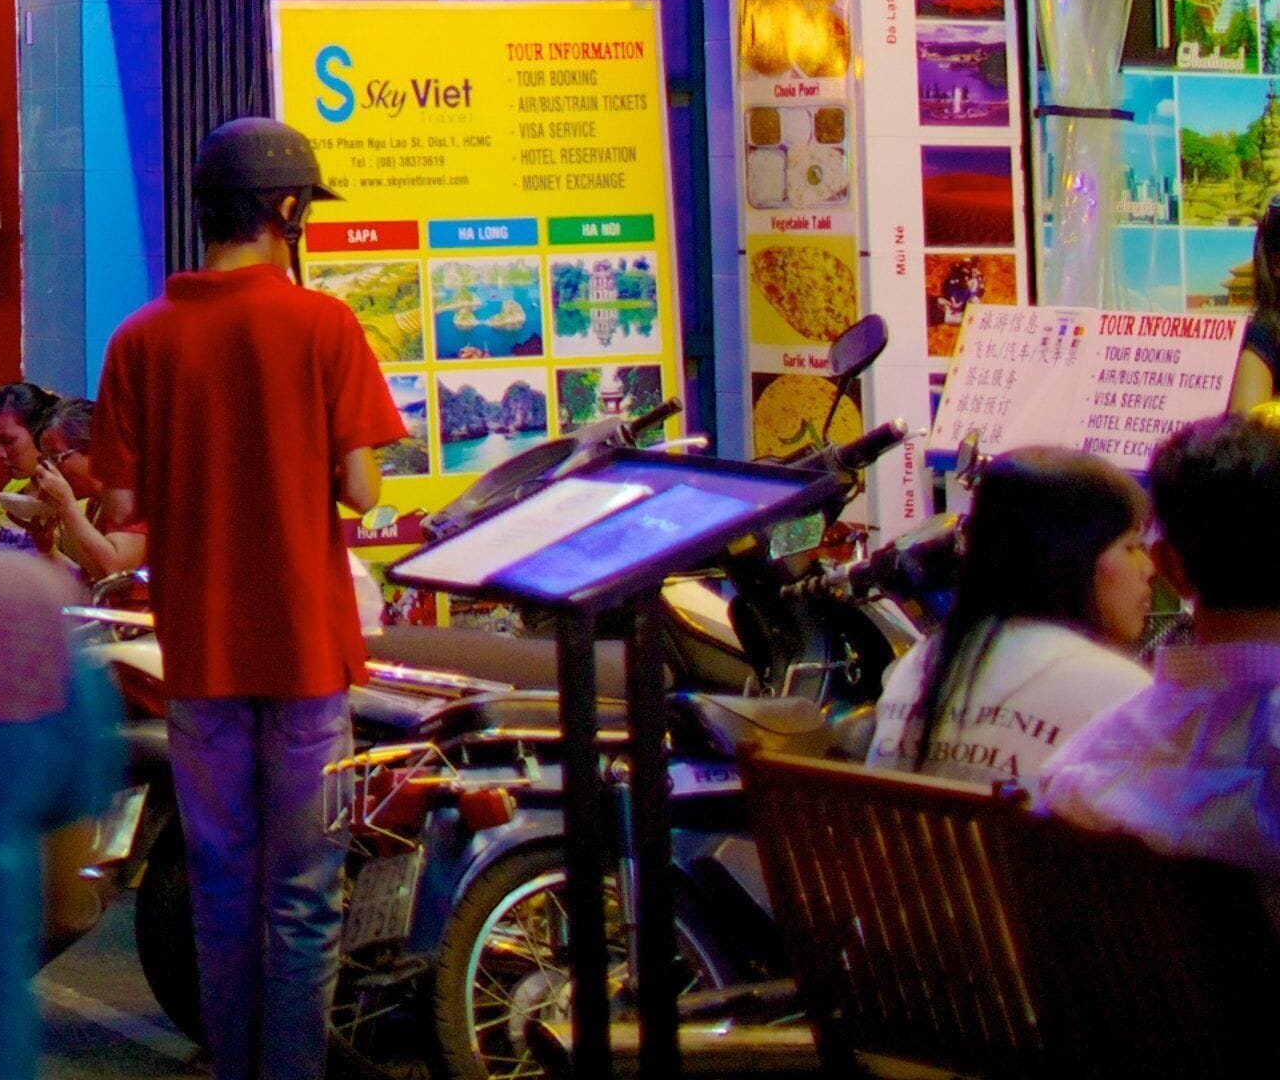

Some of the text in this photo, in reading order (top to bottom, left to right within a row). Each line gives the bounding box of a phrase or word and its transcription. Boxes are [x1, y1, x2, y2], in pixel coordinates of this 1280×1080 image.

[505, 40, 645, 62] TOUR INFORMATION
[516, 68, 598, 87] TOUR BOOKING
[361, 78, 473, 119] Sky Viet
[602, 93, 648, 112] TICKETS
[518, 120, 597, 140] VISA SERVICE
[520, 146, 637, 165] HOTEL RESERVATION
[522, 172, 627, 192] MONEY EXCHANGE
[347, 228, 378, 244] SAPA
[458, 226, 509, 241] HA LONG
[581, 223, 599, 237] HA
[1098, 314, 1237, 341] TOUR INFORMATION
[1104, 345, 1181, 365] TOUR BOOKING
[1178, 372, 1224, 391] TICKETS
[1093, 391, 1168, 411] VISA SERVICE
[1087, 414, 1120, 432] HOTEL
[1081, 436, 1121, 455] MONEY
[975, 705, 1060, 747] PENH
